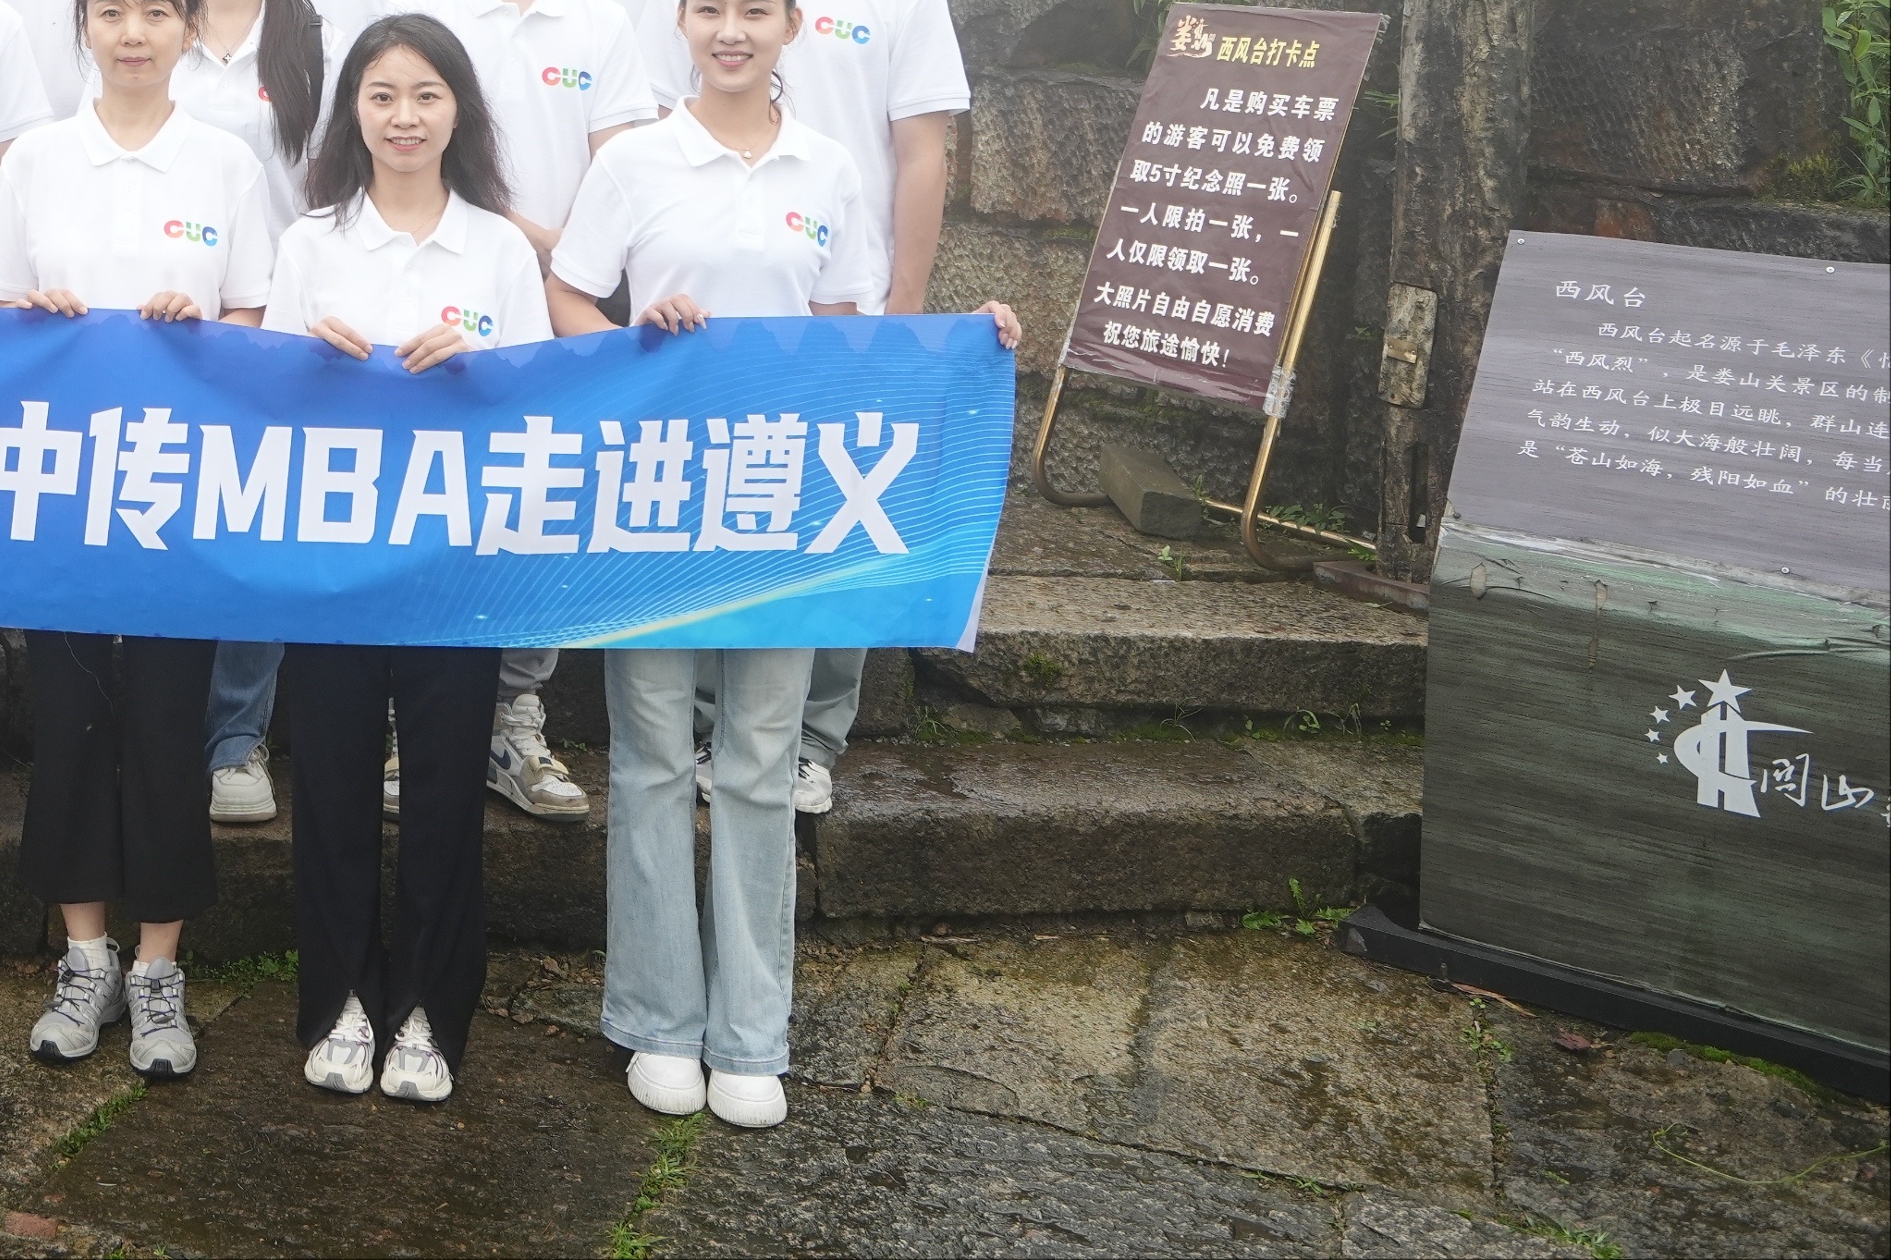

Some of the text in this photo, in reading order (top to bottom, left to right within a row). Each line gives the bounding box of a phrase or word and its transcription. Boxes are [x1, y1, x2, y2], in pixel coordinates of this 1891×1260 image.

[814, 16, 871, 45] CUC
[1217, 36, 1321, 69] 西风台打卡点
[541, 66, 593, 91] CUC
[1200, 88, 1339, 122] 凡是购买车票
[1142, 121, 1324, 163] 的游客可以免费领
[1130, 160, 1298, 204] 取5寸纪念照一张。
[163, 219, 218, 247] CUC
[785, 211, 830, 248] CUC
[1120, 202, 1299, 243] 一人限拍一张，一
[1106, 239, 1259, 286] 人仅限领取一张。
[1094, 282, 1275, 337] 大照片自由自愿消费
[1555, 280, 1647, 308] 西风台
[441, 305, 494, 337] CUC
